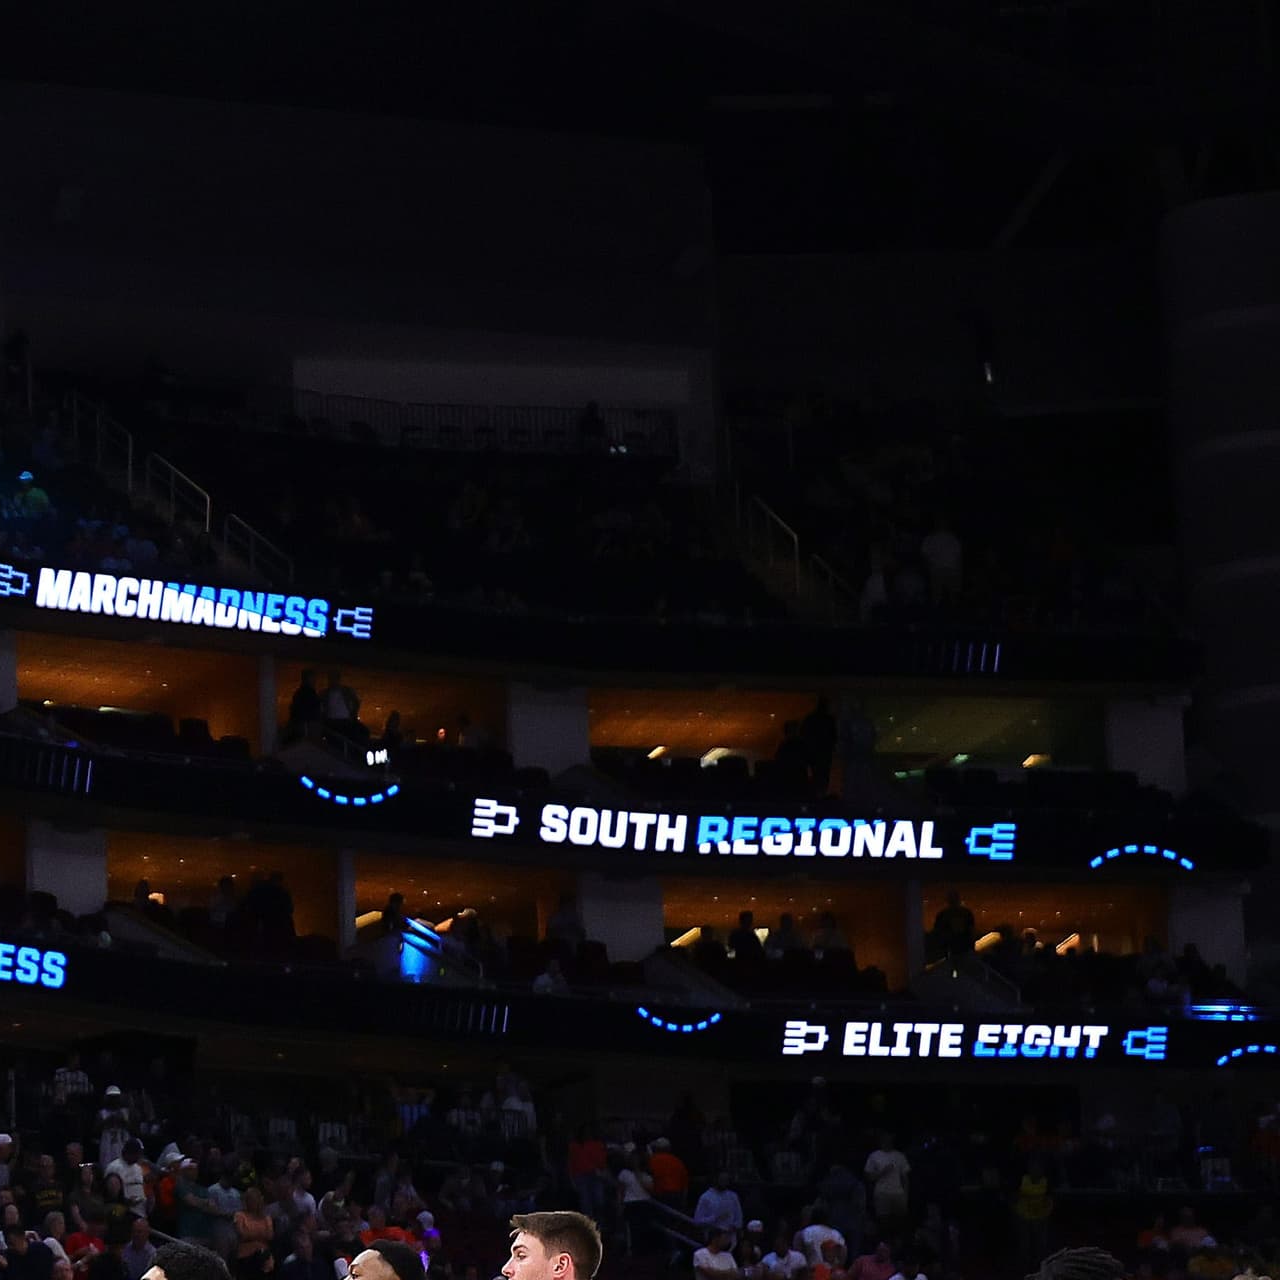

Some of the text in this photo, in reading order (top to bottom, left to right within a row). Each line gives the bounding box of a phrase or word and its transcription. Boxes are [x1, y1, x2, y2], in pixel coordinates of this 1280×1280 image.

[540, 804, 943, 858] SOUTH REGIONAL
[843, 1022, 1108, 1058] ELITE EIGHT
